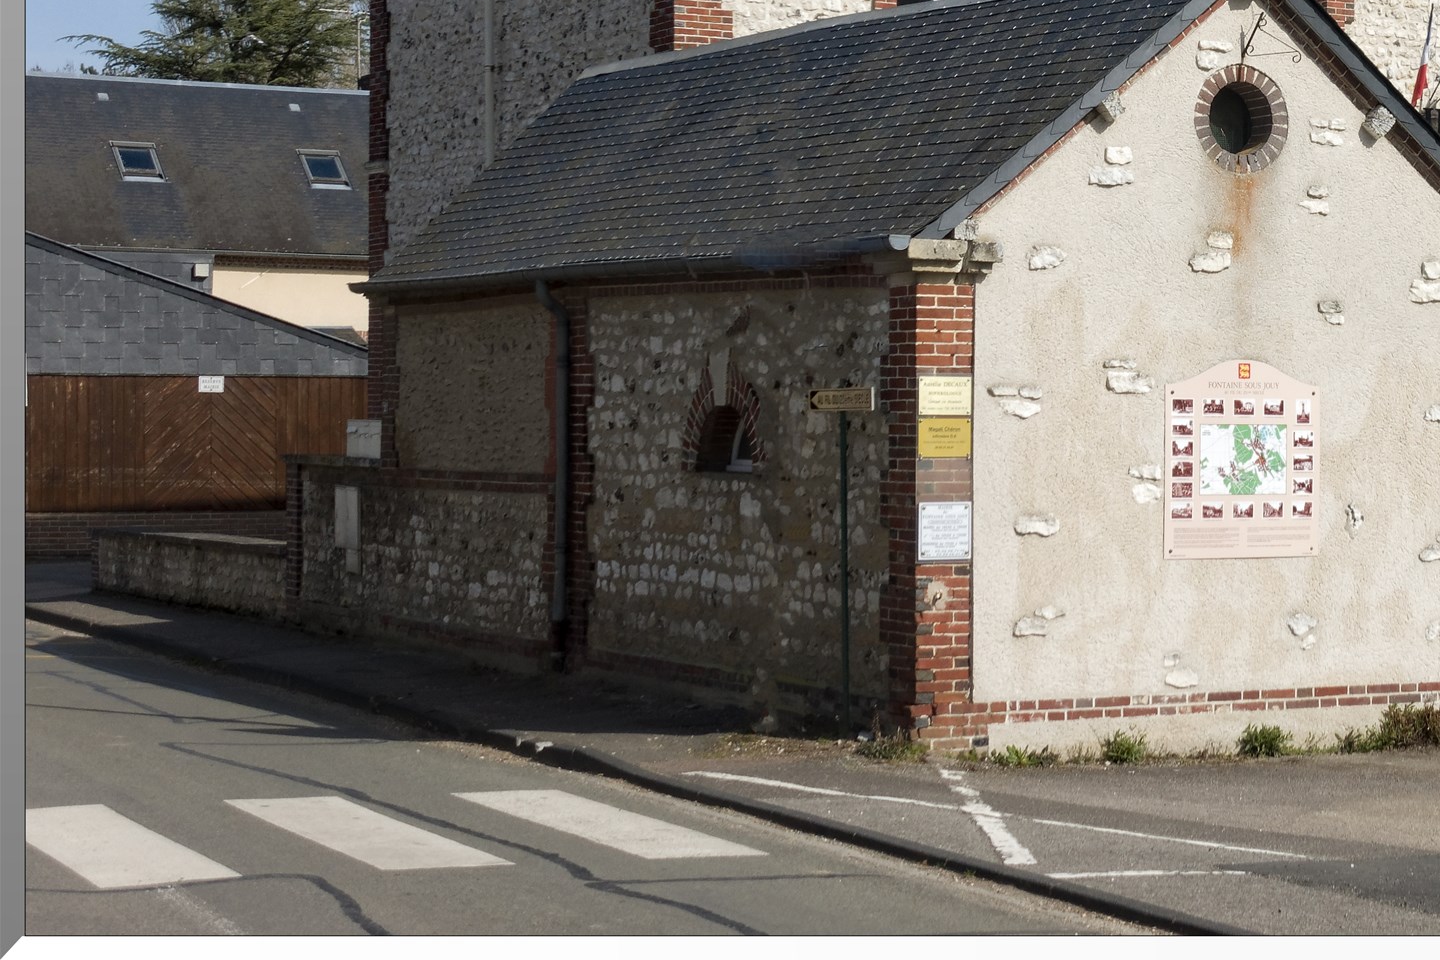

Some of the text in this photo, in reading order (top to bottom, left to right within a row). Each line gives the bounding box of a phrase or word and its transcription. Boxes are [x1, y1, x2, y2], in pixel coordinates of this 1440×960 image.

[1208, 381, 1280, 391] FONTAINE SOUS JOUY
